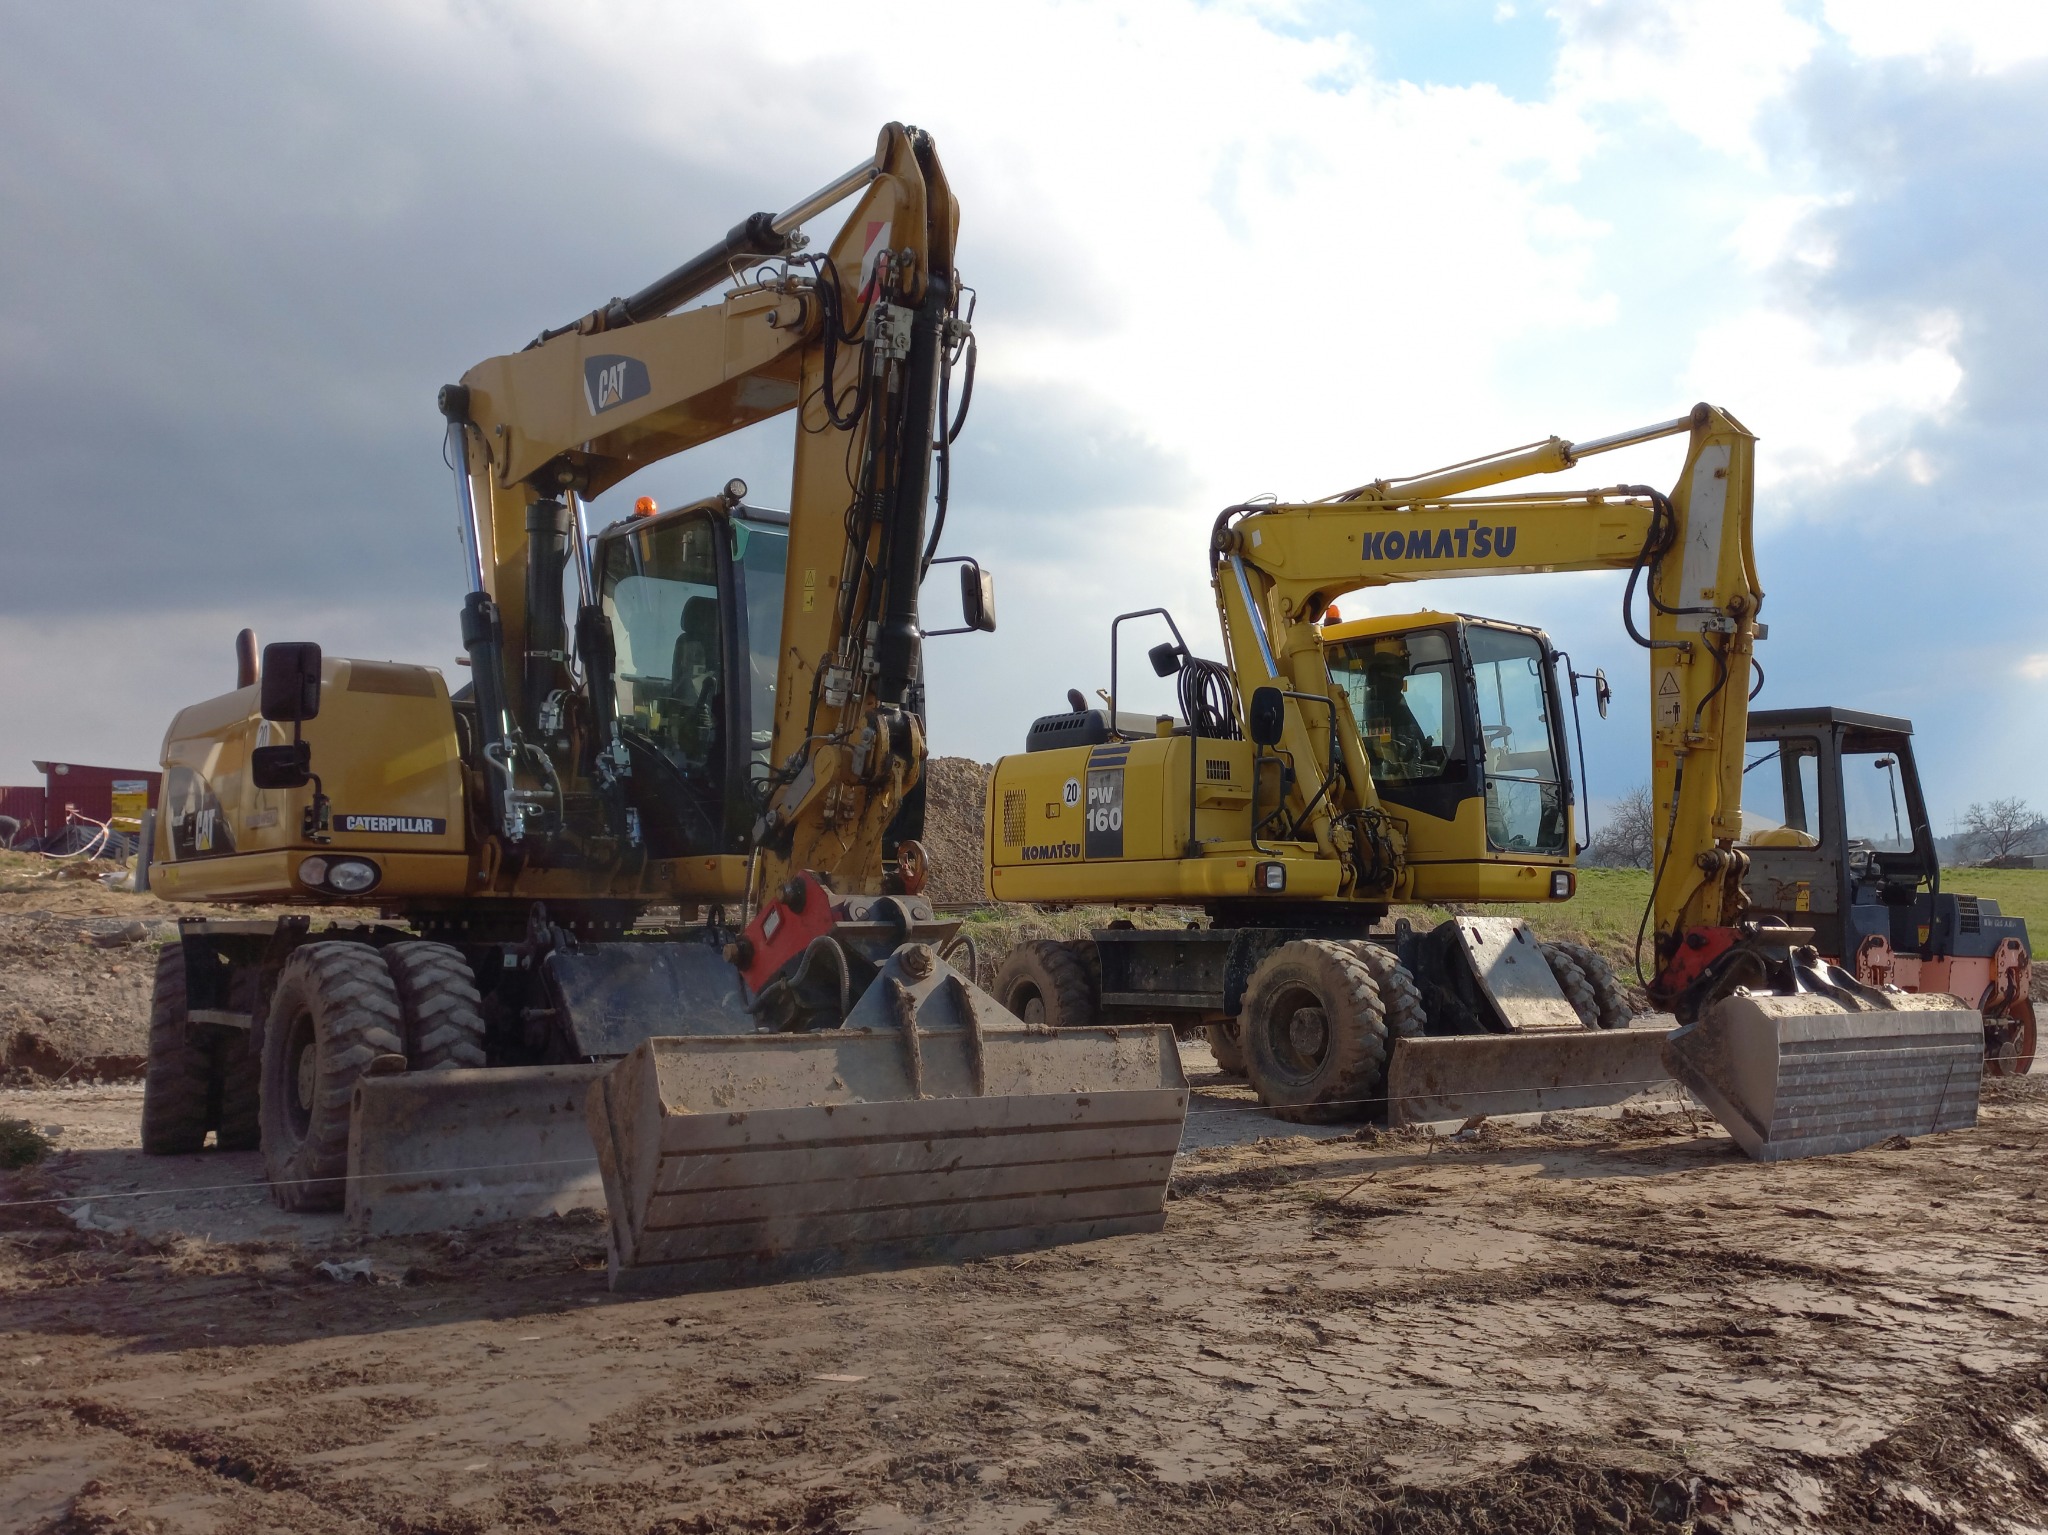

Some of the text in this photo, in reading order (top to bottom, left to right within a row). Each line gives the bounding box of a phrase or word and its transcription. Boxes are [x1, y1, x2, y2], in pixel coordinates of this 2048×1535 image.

[598, 361, 626, 408] CAT
[1361, 519, 1517, 561] KOMATSU
[1066, 783, 1078, 803] 20
[1088, 786, 1114, 805] PW
[195, 808, 216, 851] CAT
[346, 816, 433, 833] CATERPILLAR
[1086, 807, 1122, 832] 160
[1022, 840, 1081, 861] KOMATSU
